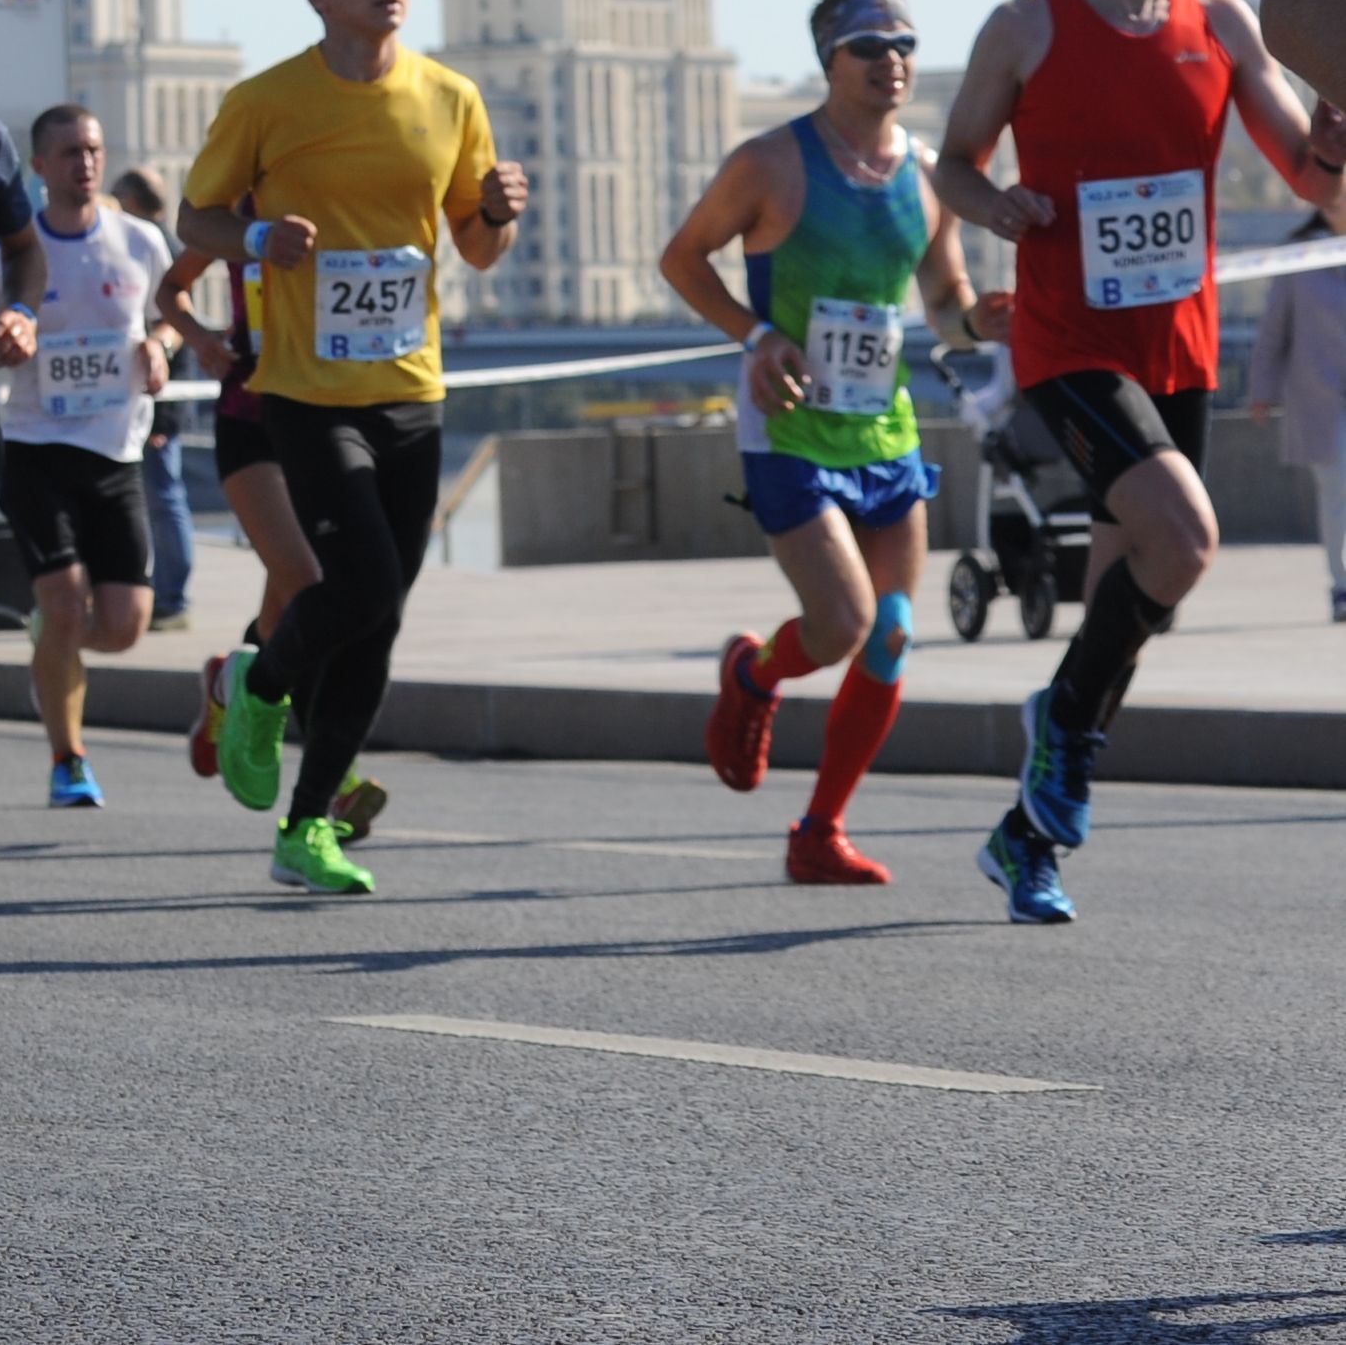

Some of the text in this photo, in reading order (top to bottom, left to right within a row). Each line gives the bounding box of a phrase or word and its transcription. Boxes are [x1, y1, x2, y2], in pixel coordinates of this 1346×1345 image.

[1097, 208, 1195, 254] 5380
[330, 276, 416, 315] 2457
[50, 353, 120, 382] 8854
